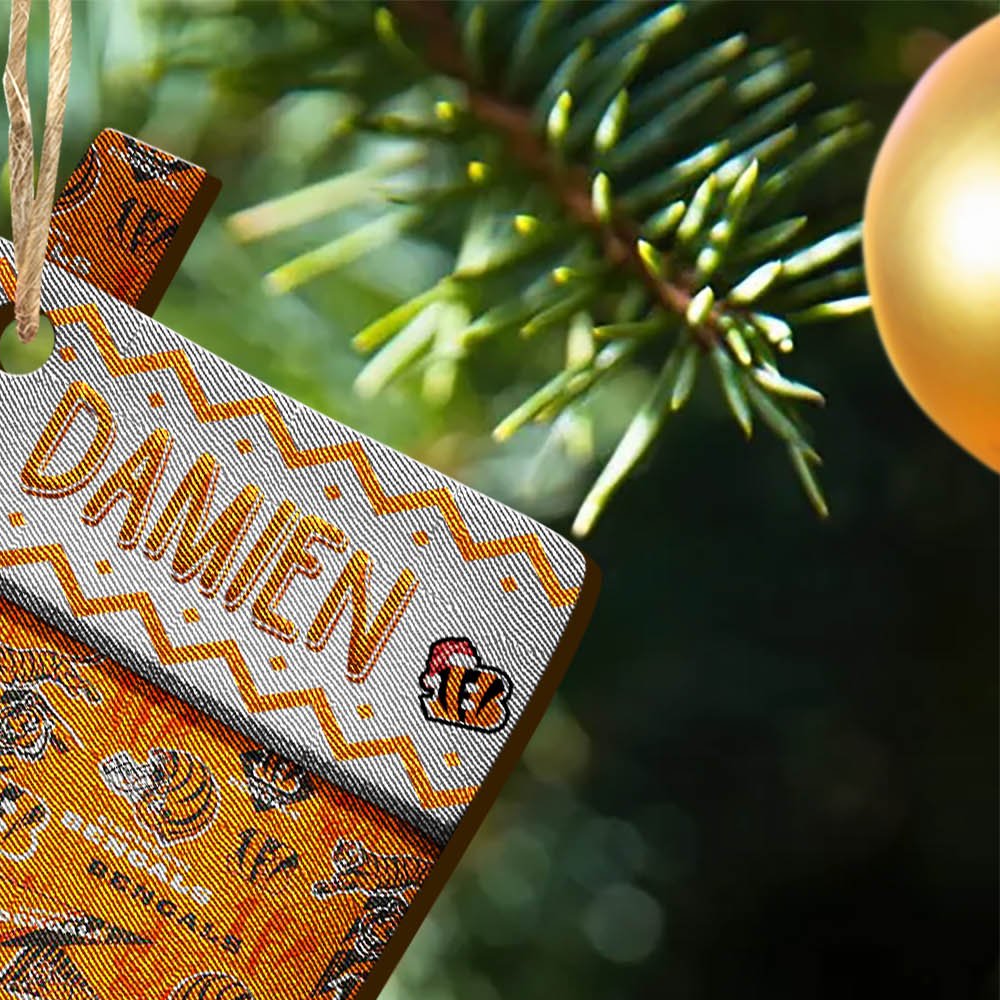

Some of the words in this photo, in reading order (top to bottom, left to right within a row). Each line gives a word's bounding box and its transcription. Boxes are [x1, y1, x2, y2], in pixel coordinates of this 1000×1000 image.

[20, 380, 420, 684] DAMIEN
[58, 808, 214, 907] BENGALS
[84, 857, 245, 957] BENGALS
